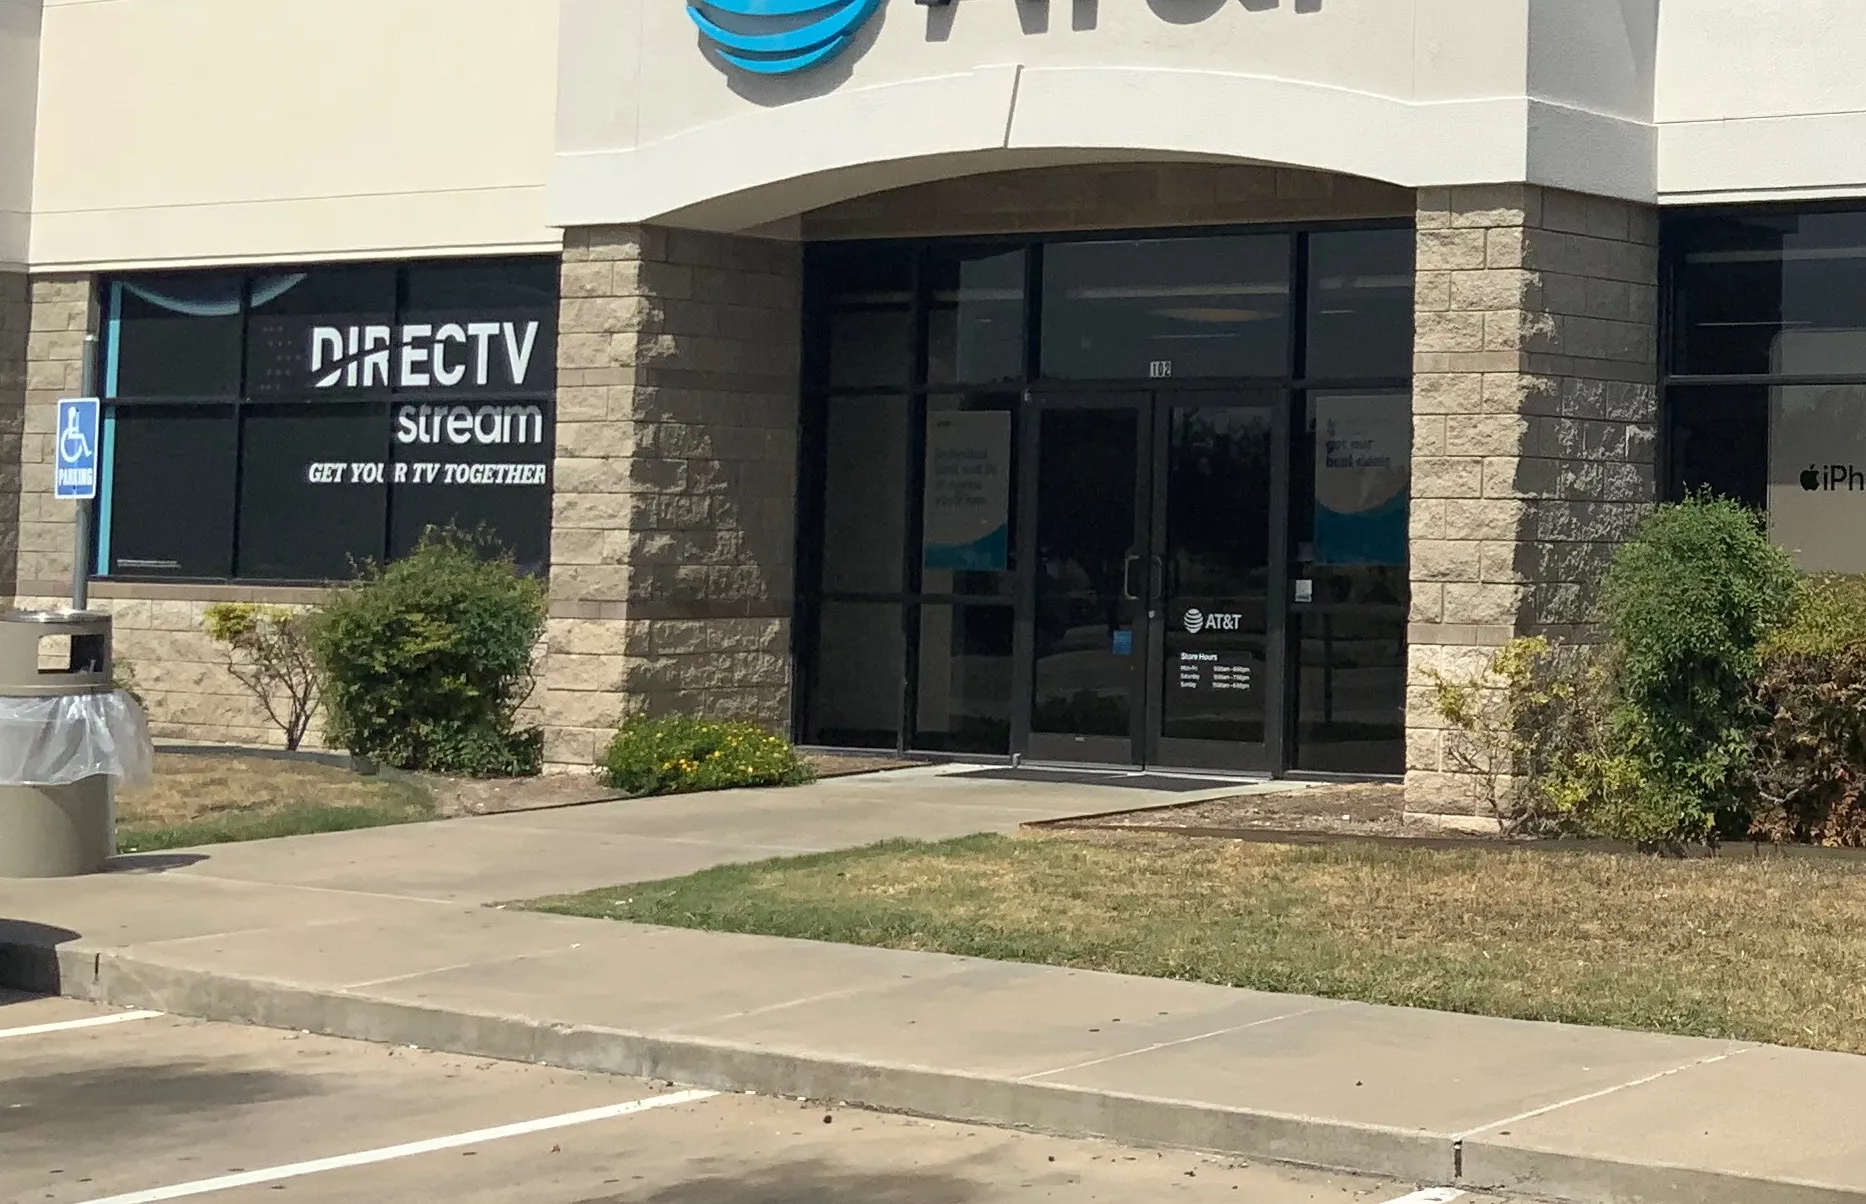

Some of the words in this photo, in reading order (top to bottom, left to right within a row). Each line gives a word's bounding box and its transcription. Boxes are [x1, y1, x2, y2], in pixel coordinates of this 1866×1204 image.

[311, 321, 539, 387] DIRECTV
[1152, 362, 1170, 377] 102
[397, 403, 543, 444] stream
[58, 468, 93, 486] PARKING
[309, 462, 346, 483] GET
[412, 463, 441, 484] TV
[444, 463, 546, 485] TOGETHER
[1205, 613, 1242, 630] AT&T
[1181, 652, 1198, 661] Store
[1199, 653, 1218, 661] Hours
